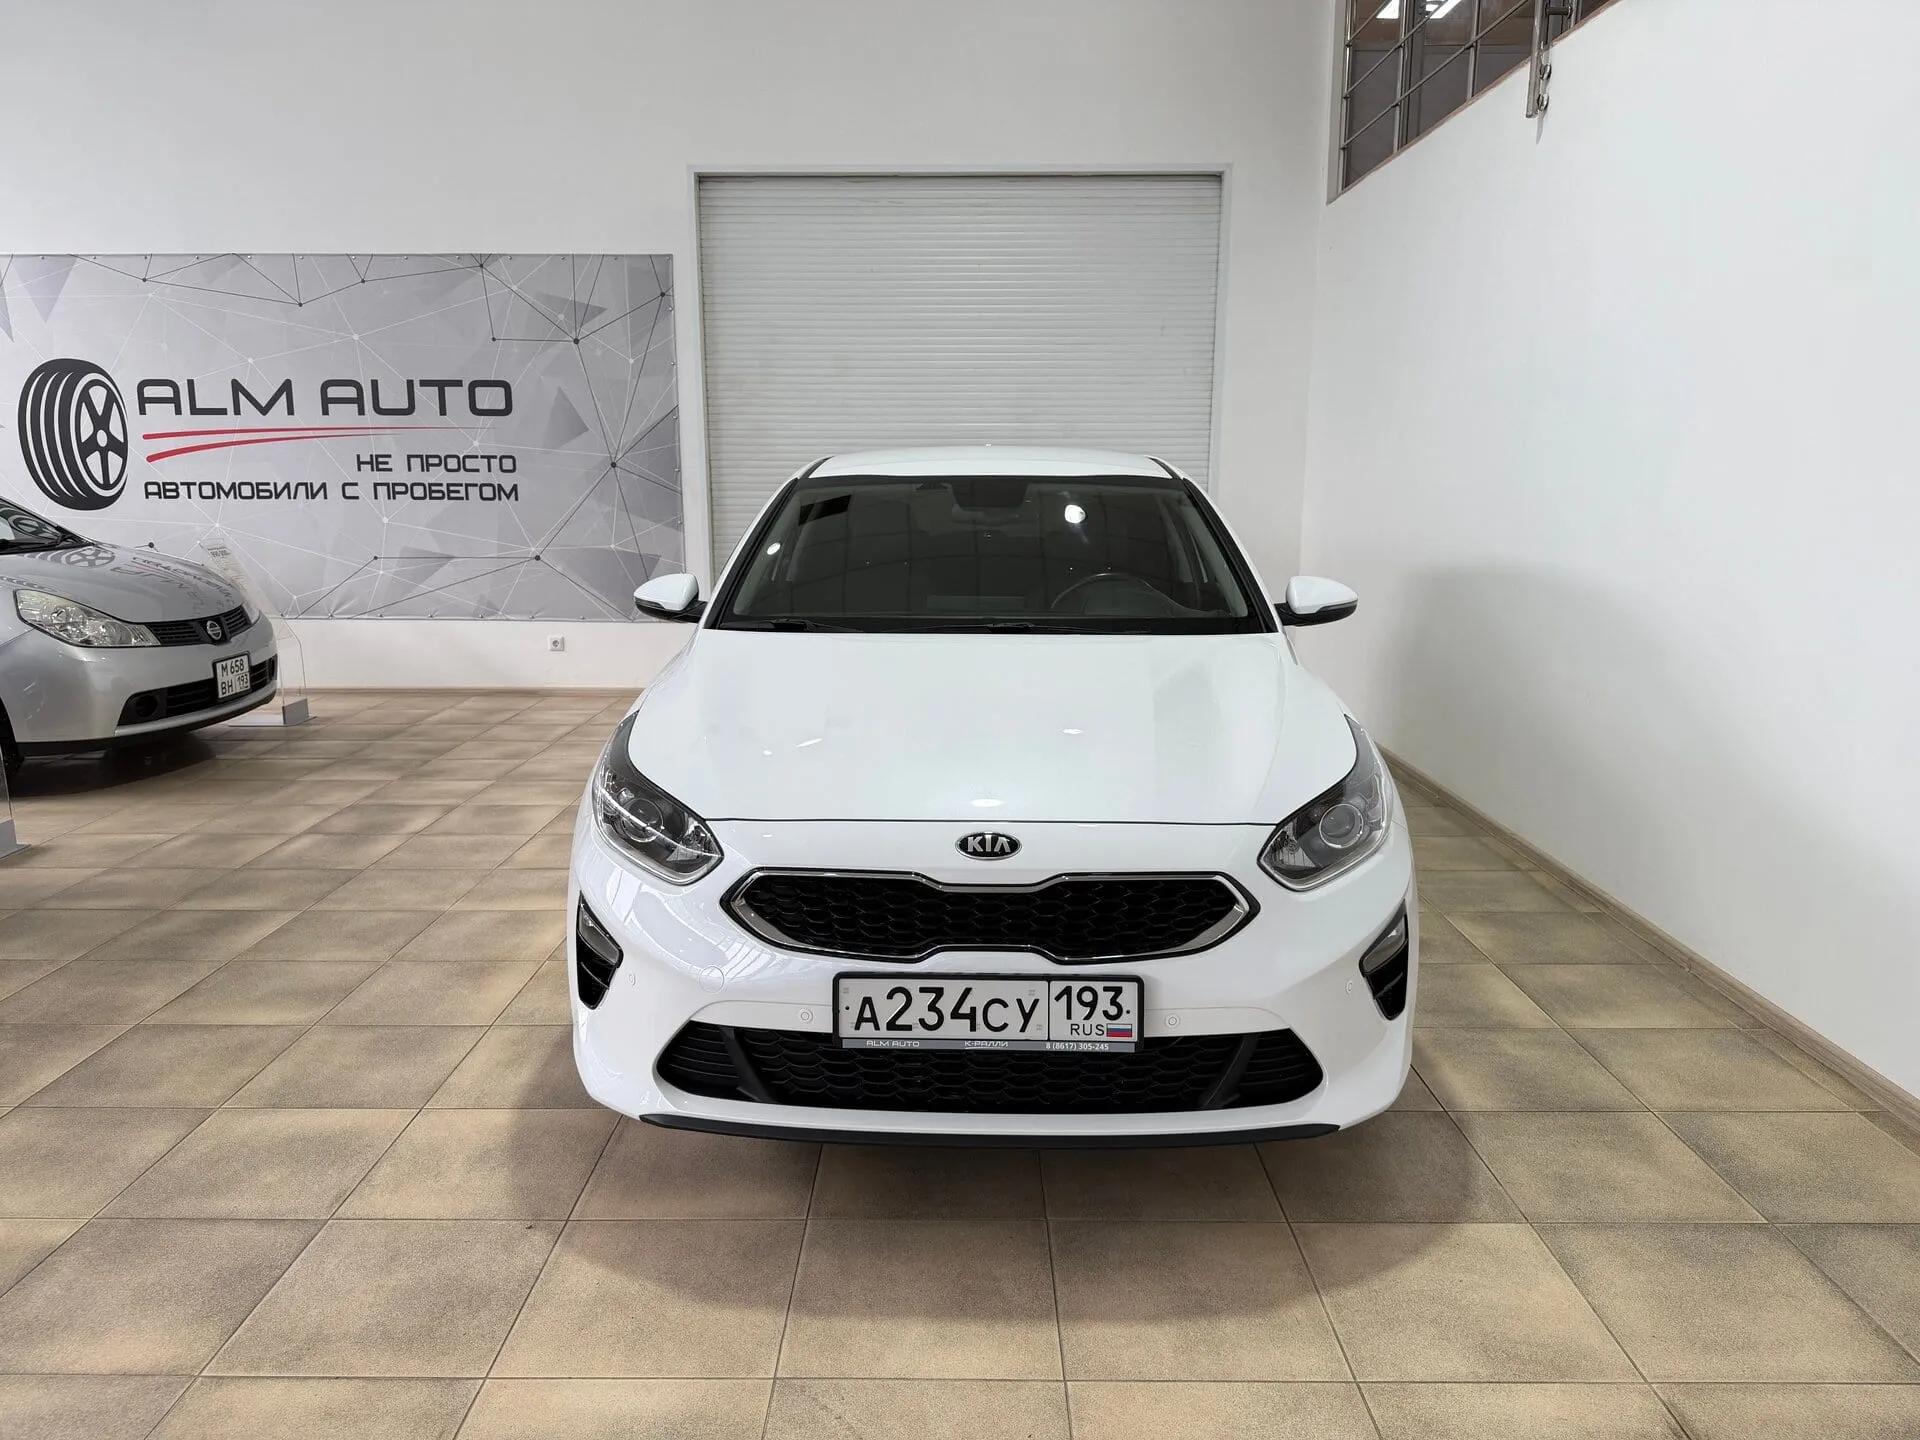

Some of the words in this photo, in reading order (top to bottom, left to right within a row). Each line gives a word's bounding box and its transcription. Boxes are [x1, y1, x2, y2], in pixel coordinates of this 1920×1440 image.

[137, 379, 294, 416] ALM
[321, 379, 512, 416] AUTO
[357, 454, 392, 472] НЕ
[407, 455, 517, 473] ПРОСТО
[144, 481, 328, 500] АВТОМОБИЛИ
[342, 483, 359, 500] С
[374, 483, 518, 501] ПРОБЕГОМ
[967, 834, 1011, 853] KIA
[1054, 985, 1123, 1021] 193
[1070, 1023, 1105, 1036] RUS
[866, 1040, 889, 1048] ALM
[892, 1040, 920, 1048] AUTO
[1052, 1042, 1077, 1051] (8617)
[1078, 1043, 1109, 1051] 305-245
